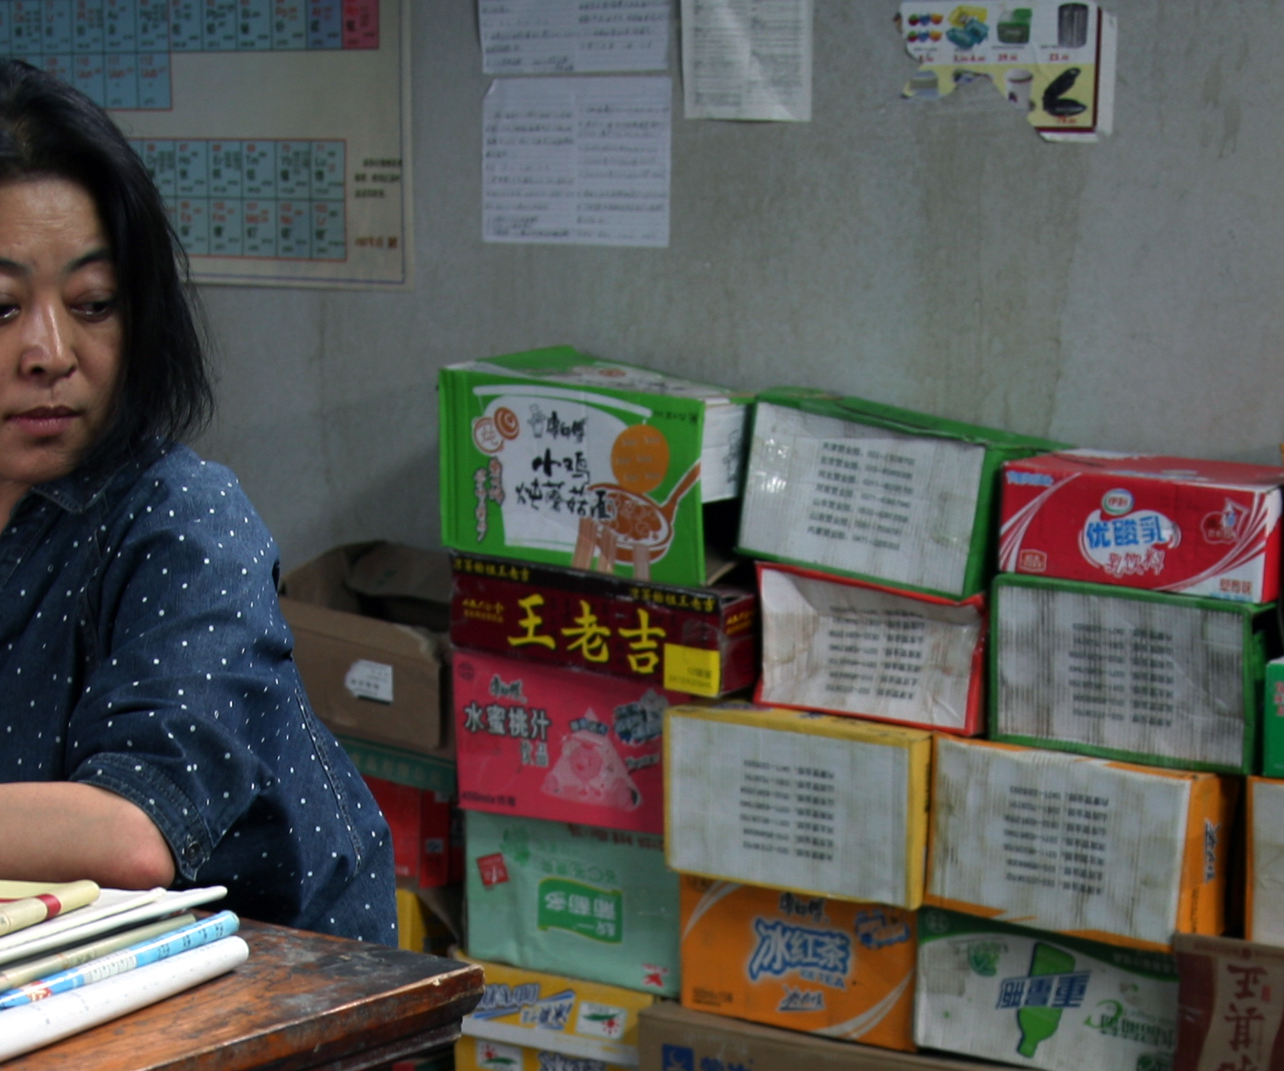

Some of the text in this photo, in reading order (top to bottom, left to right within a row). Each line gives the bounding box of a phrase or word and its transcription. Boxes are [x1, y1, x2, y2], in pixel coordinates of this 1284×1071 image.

[1086, 514, 1166, 550] 优酸乳
[507, 593, 667, 675] 王老吉
[464, 702, 551, 741] 水蜜桃汁
[749, 917, 851, 981] 冰红茶
[818, 973, 846, 990] TEA
[995, 970, 1091, 1010] 重量瓶
